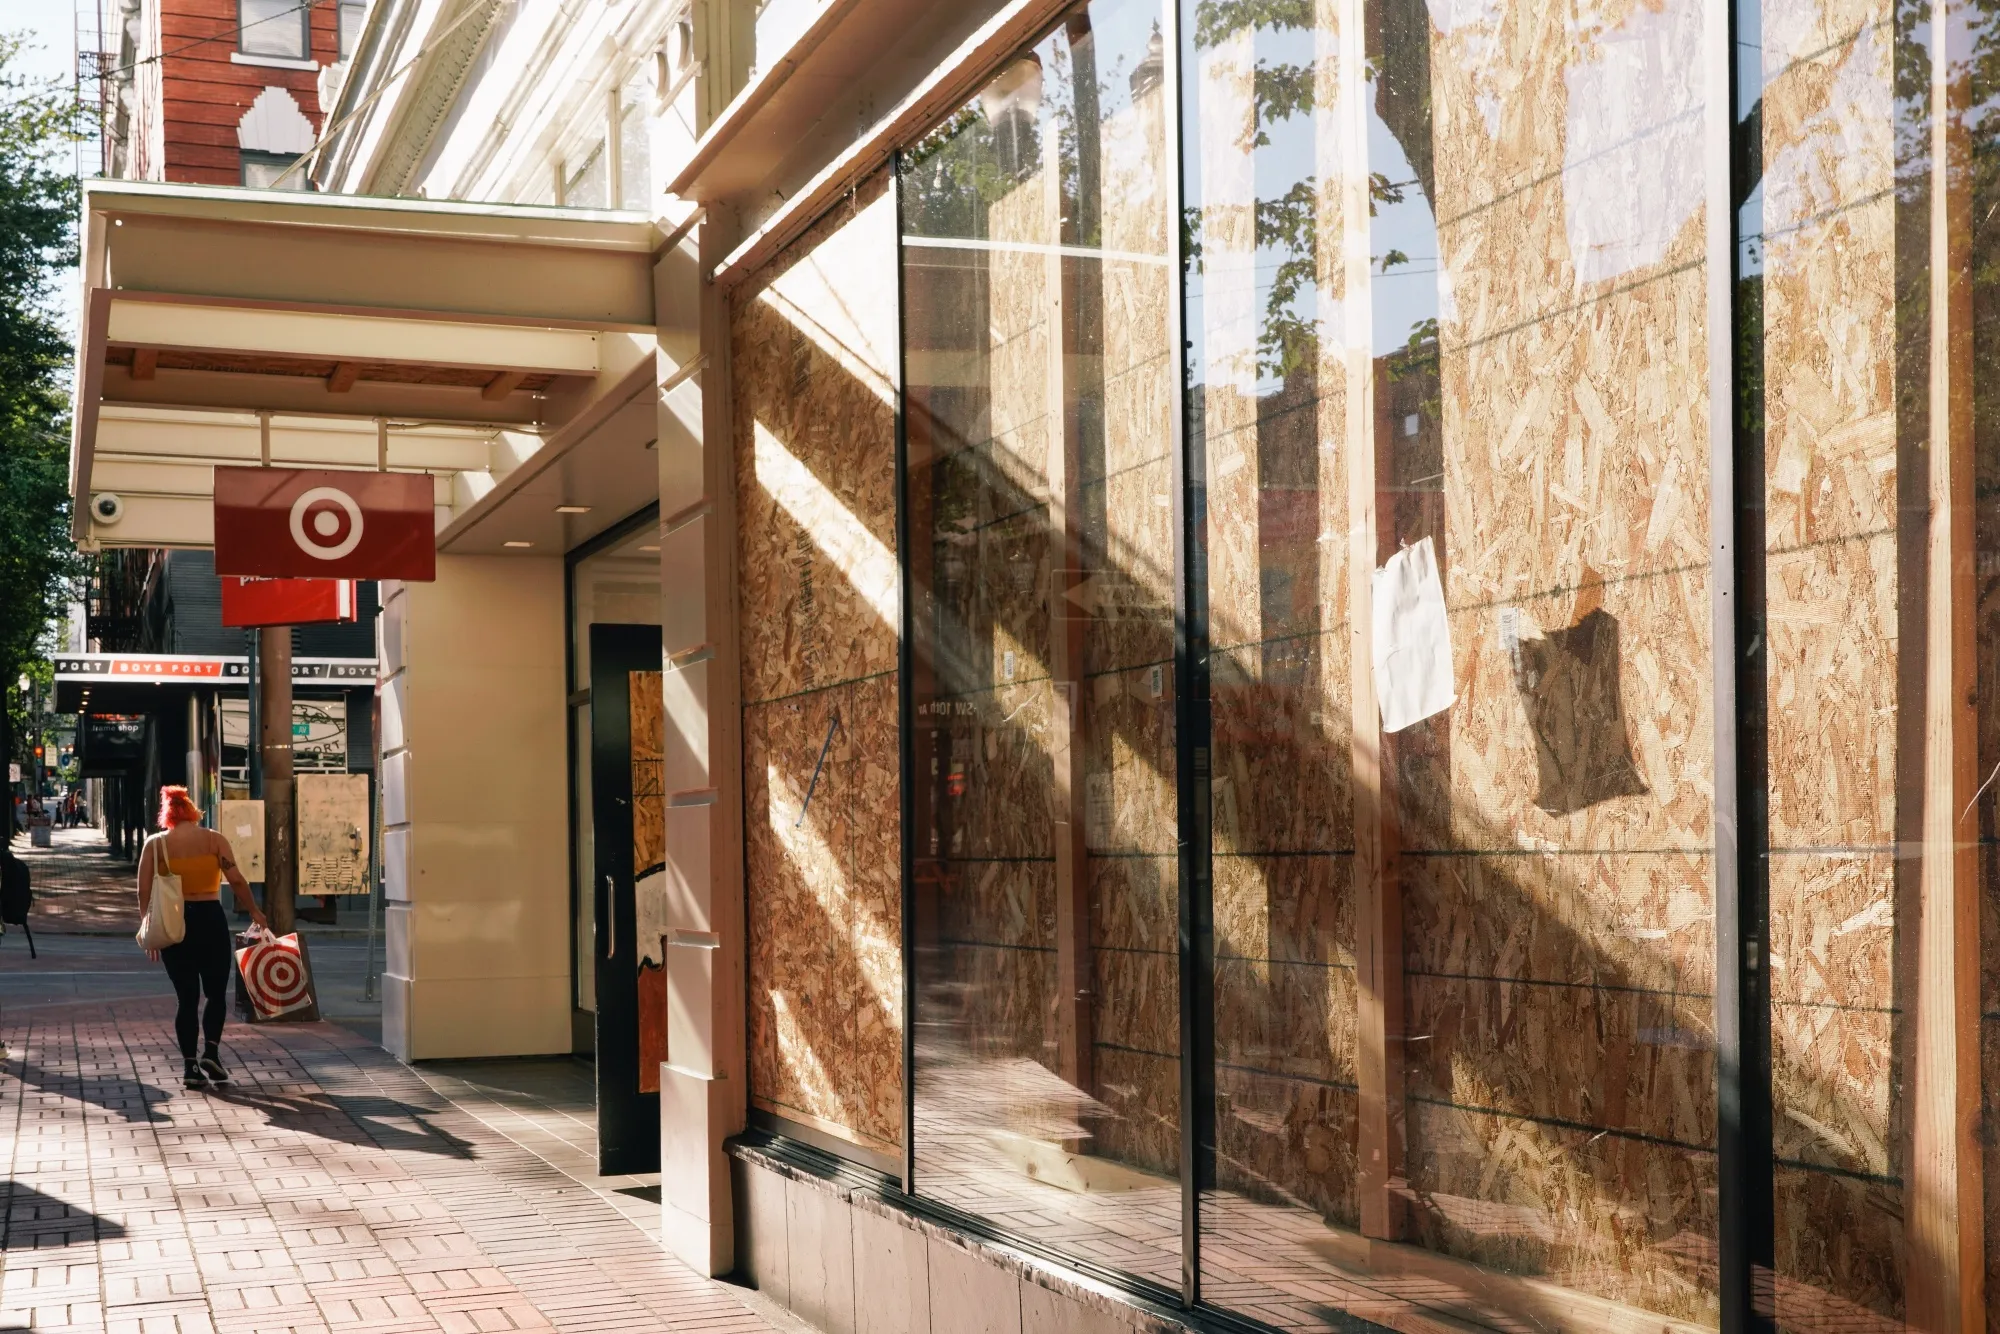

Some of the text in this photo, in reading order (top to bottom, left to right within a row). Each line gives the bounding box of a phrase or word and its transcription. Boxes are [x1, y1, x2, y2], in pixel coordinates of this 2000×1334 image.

[59, 662, 102, 671] FORT
[120, 663, 213, 673] BOYS FORT
[291, 667, 320, 675] ORT
[337, 667, 377, 676] BOYS
[118, 723, 139, 733] shop
